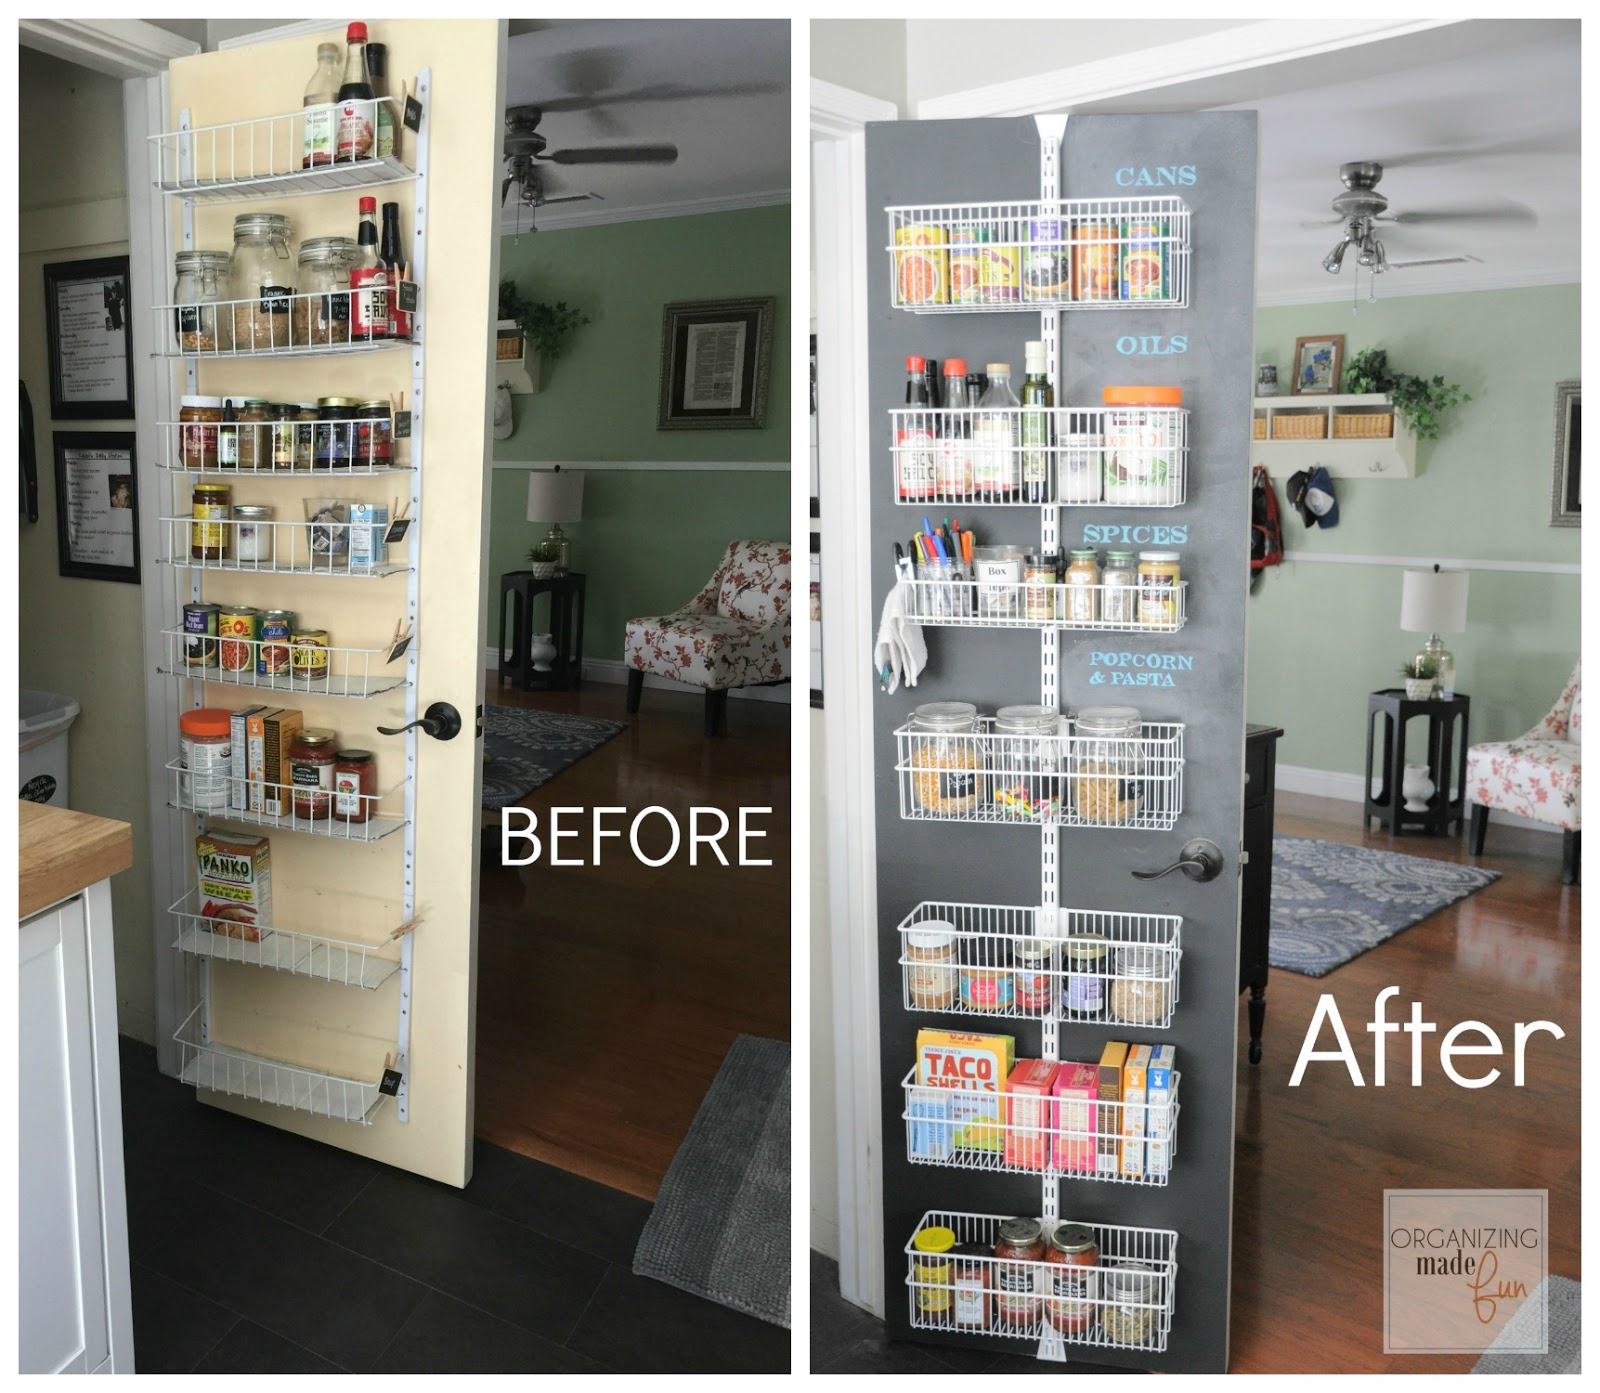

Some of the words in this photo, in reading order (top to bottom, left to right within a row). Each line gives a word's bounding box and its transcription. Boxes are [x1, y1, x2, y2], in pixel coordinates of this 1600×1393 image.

[1115, 165, 1197, 188] CANS
[1115, 335, 1189, 355] OILS
[1082, 524, 1189, 545] SPICES
[988, 566, 1008, 576] Box
[1090, 651, 1194, 672] POPCORN
[1089, 672, 1107, 686] &
[1111, 672, 1176, 687] PASTA
[203, 854, 249, 877] PANKO
[204, 887, 252, 901] WHEAT
[221, 886, 252, 895] WHOLE
[924, 1053, 992, 1080] TACO
[926, 1076, 996, 1092] SHELLS
